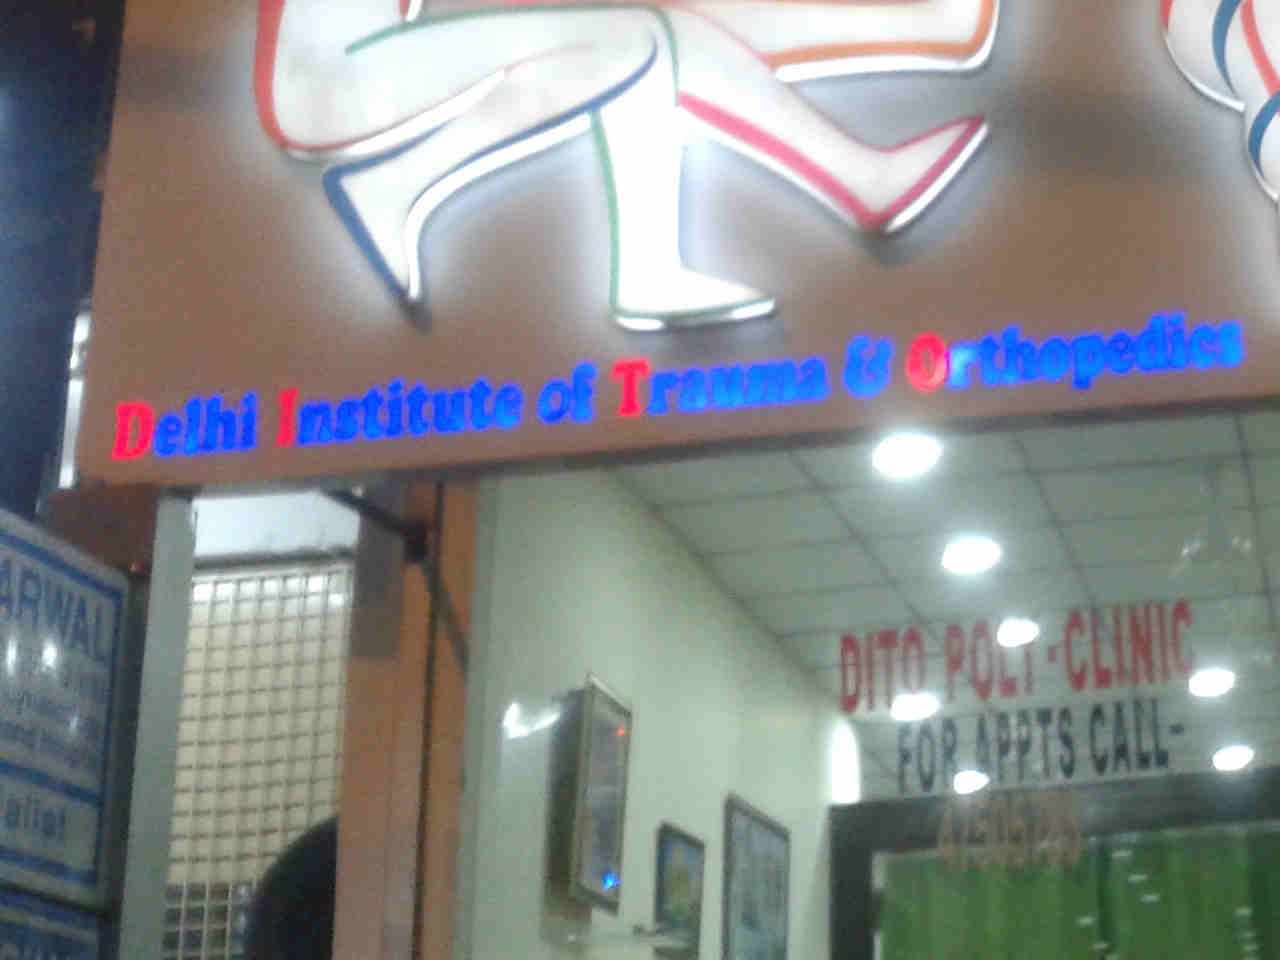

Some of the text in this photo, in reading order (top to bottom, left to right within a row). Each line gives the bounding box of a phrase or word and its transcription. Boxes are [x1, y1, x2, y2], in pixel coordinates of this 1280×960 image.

[111, 311, 1244, 460] Delhi Institute of Trauma & Orthopedics
[838, 628, 928, 713] DITO
[897, 719, 960, 795] FOR
